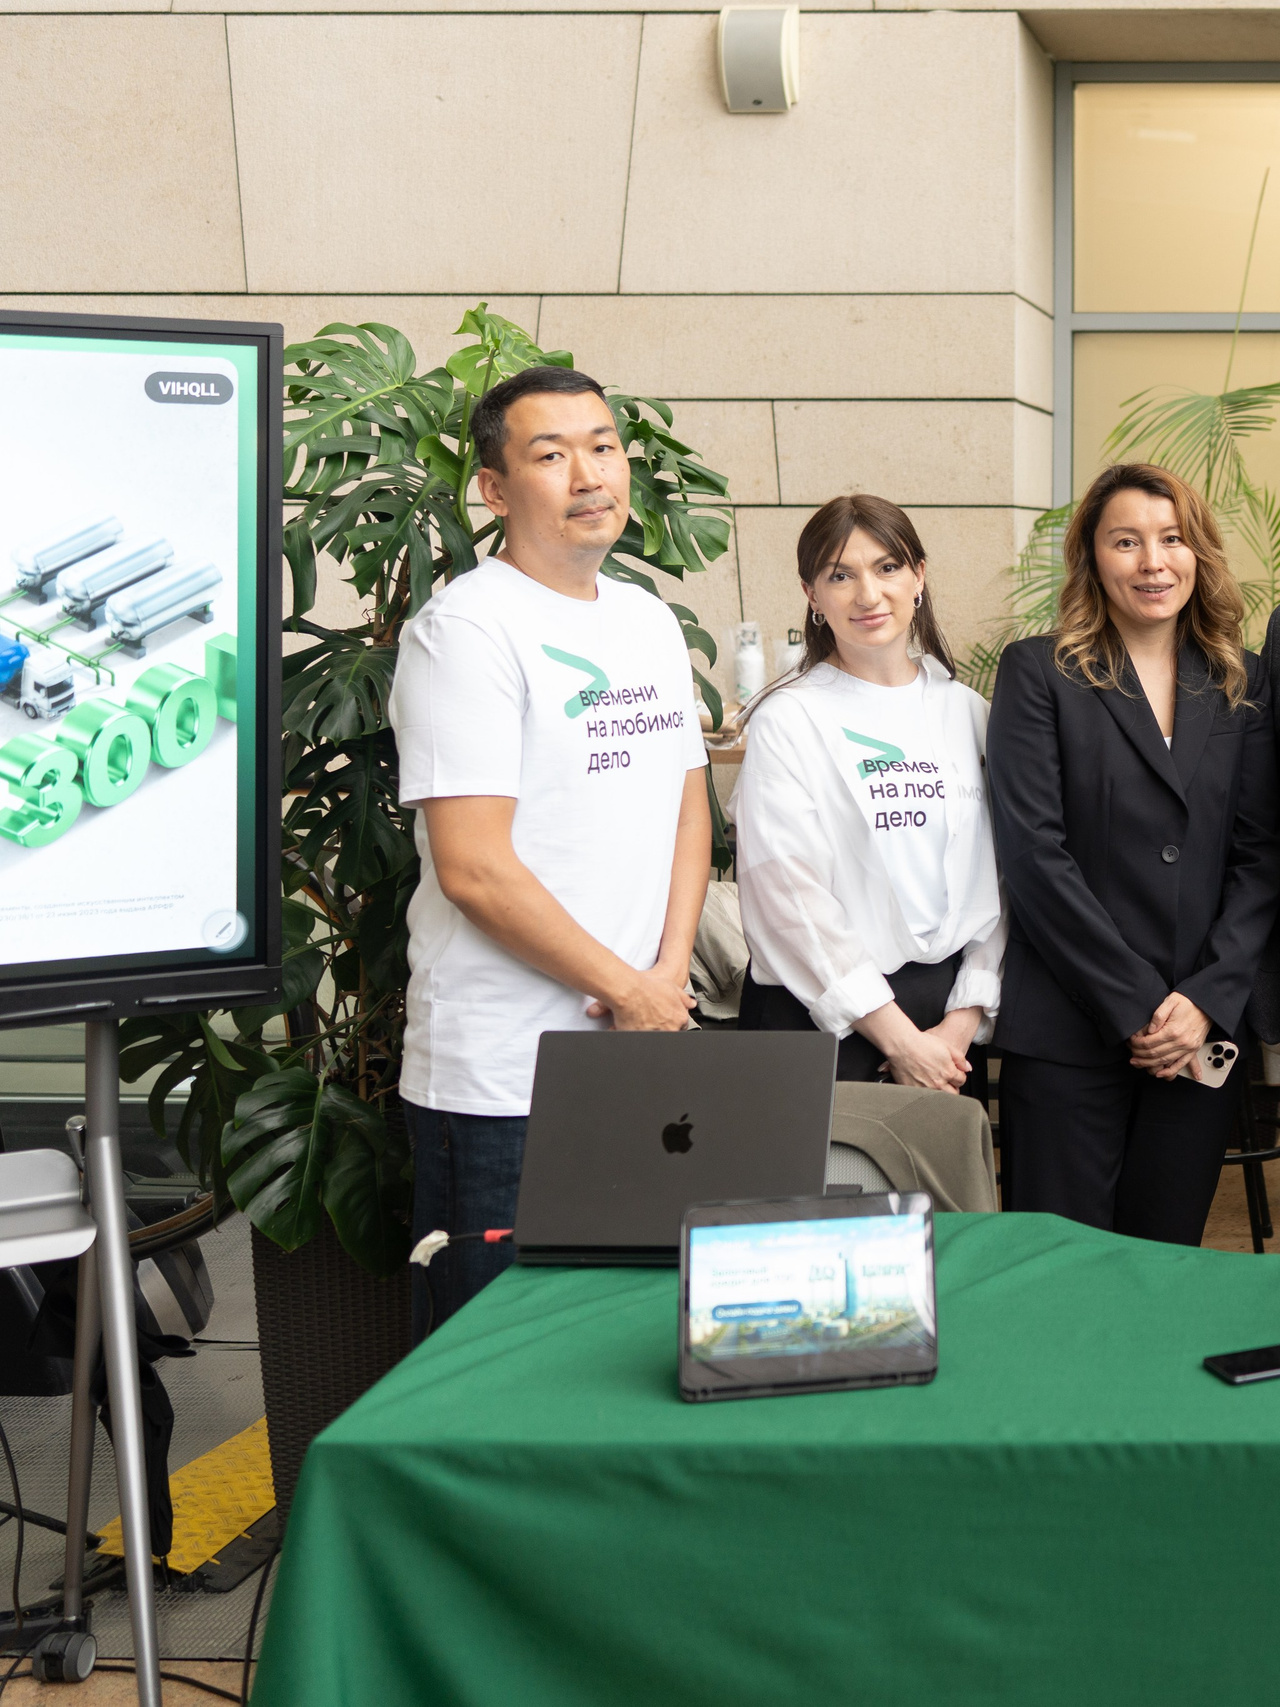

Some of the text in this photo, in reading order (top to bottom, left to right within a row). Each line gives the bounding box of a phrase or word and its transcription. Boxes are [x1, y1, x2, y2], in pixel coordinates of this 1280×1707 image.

[158, 380, 220, 398] VIHQLL
[579, 685, 658, 713] времени
[586, 710, 685, 738] на любимое
[587, 751, 631, 775] дело
[869, 782, 899, 800] на
[875, 810, 927, 832] дело
